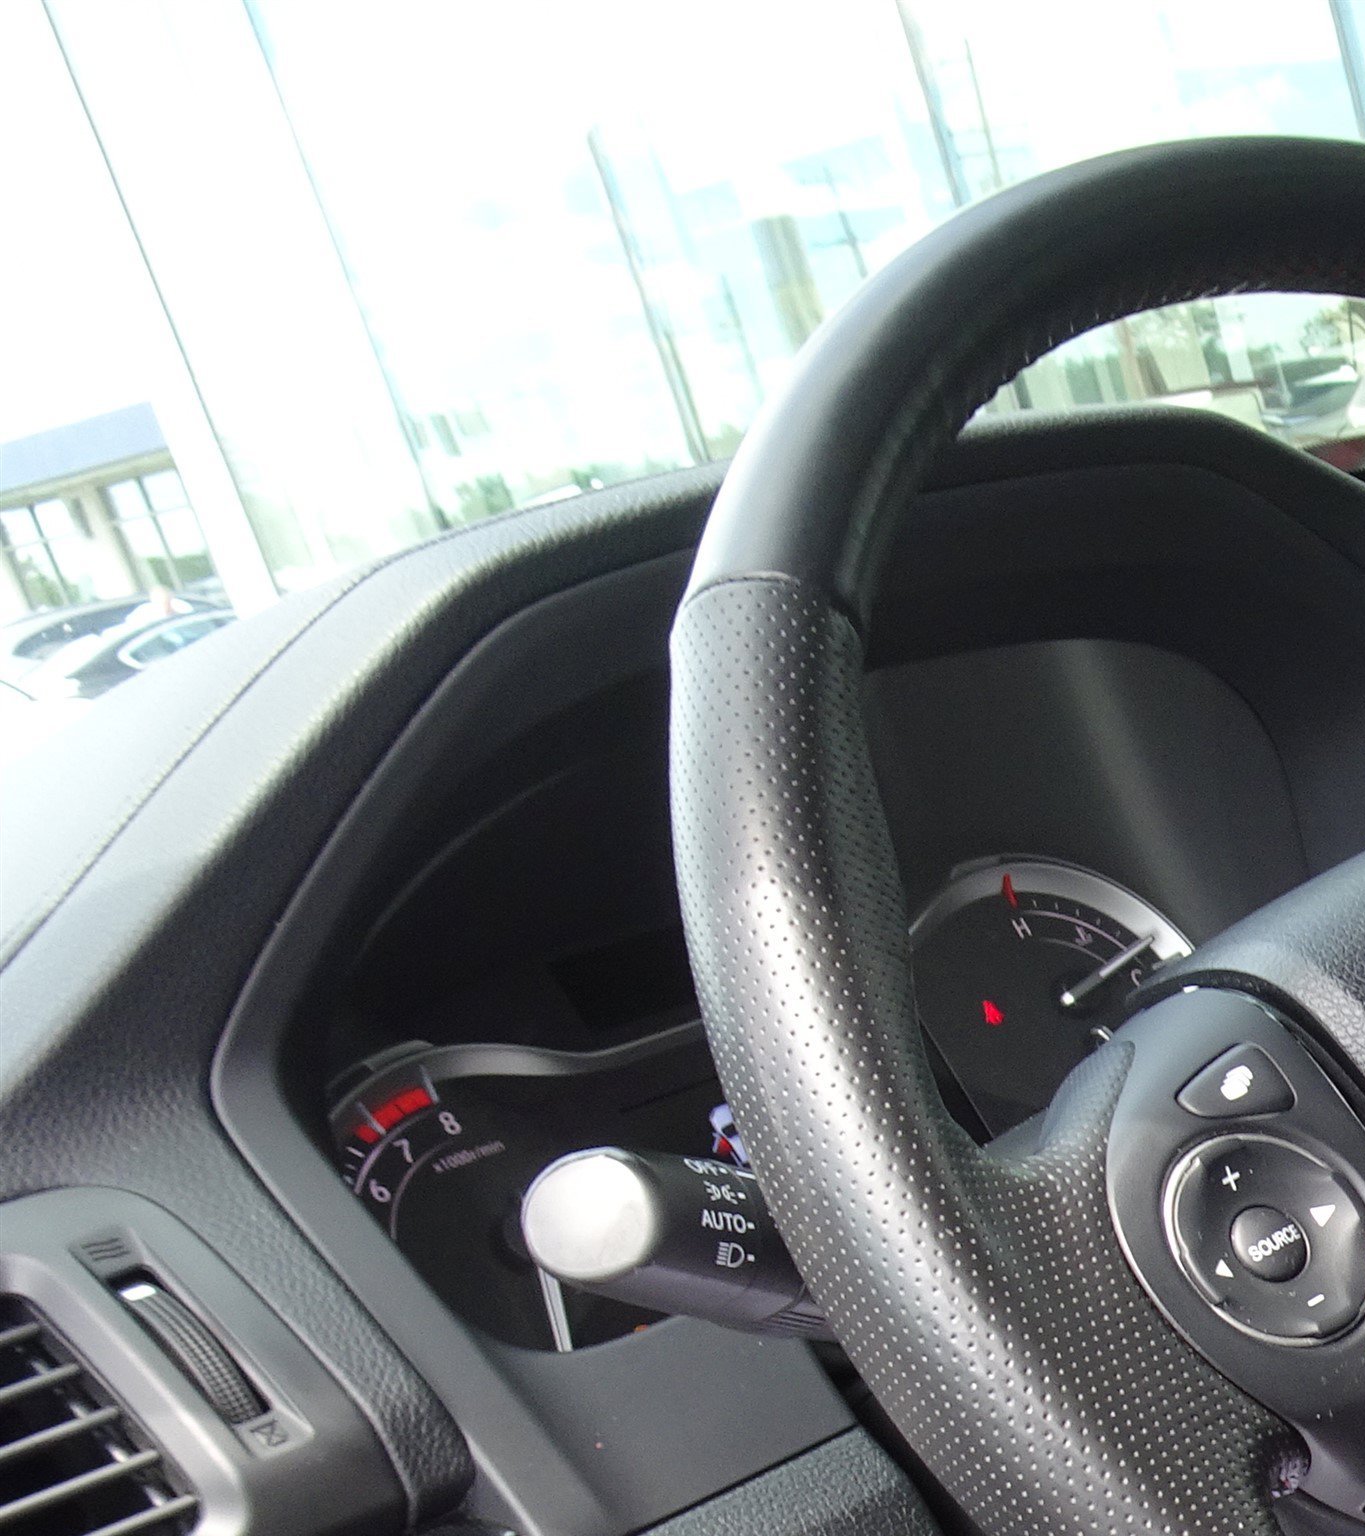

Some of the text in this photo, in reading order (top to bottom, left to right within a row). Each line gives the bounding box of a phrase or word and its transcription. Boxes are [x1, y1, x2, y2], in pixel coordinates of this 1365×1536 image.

[437, 1110, 463, 1136] 8
[392, 1137, 415, 1164] 7
[368, 1178, 392, 1203] 6
[701, 1208, 747, 1234] AUTO
[1248, 1222, 1302, 1262] SOURCE
